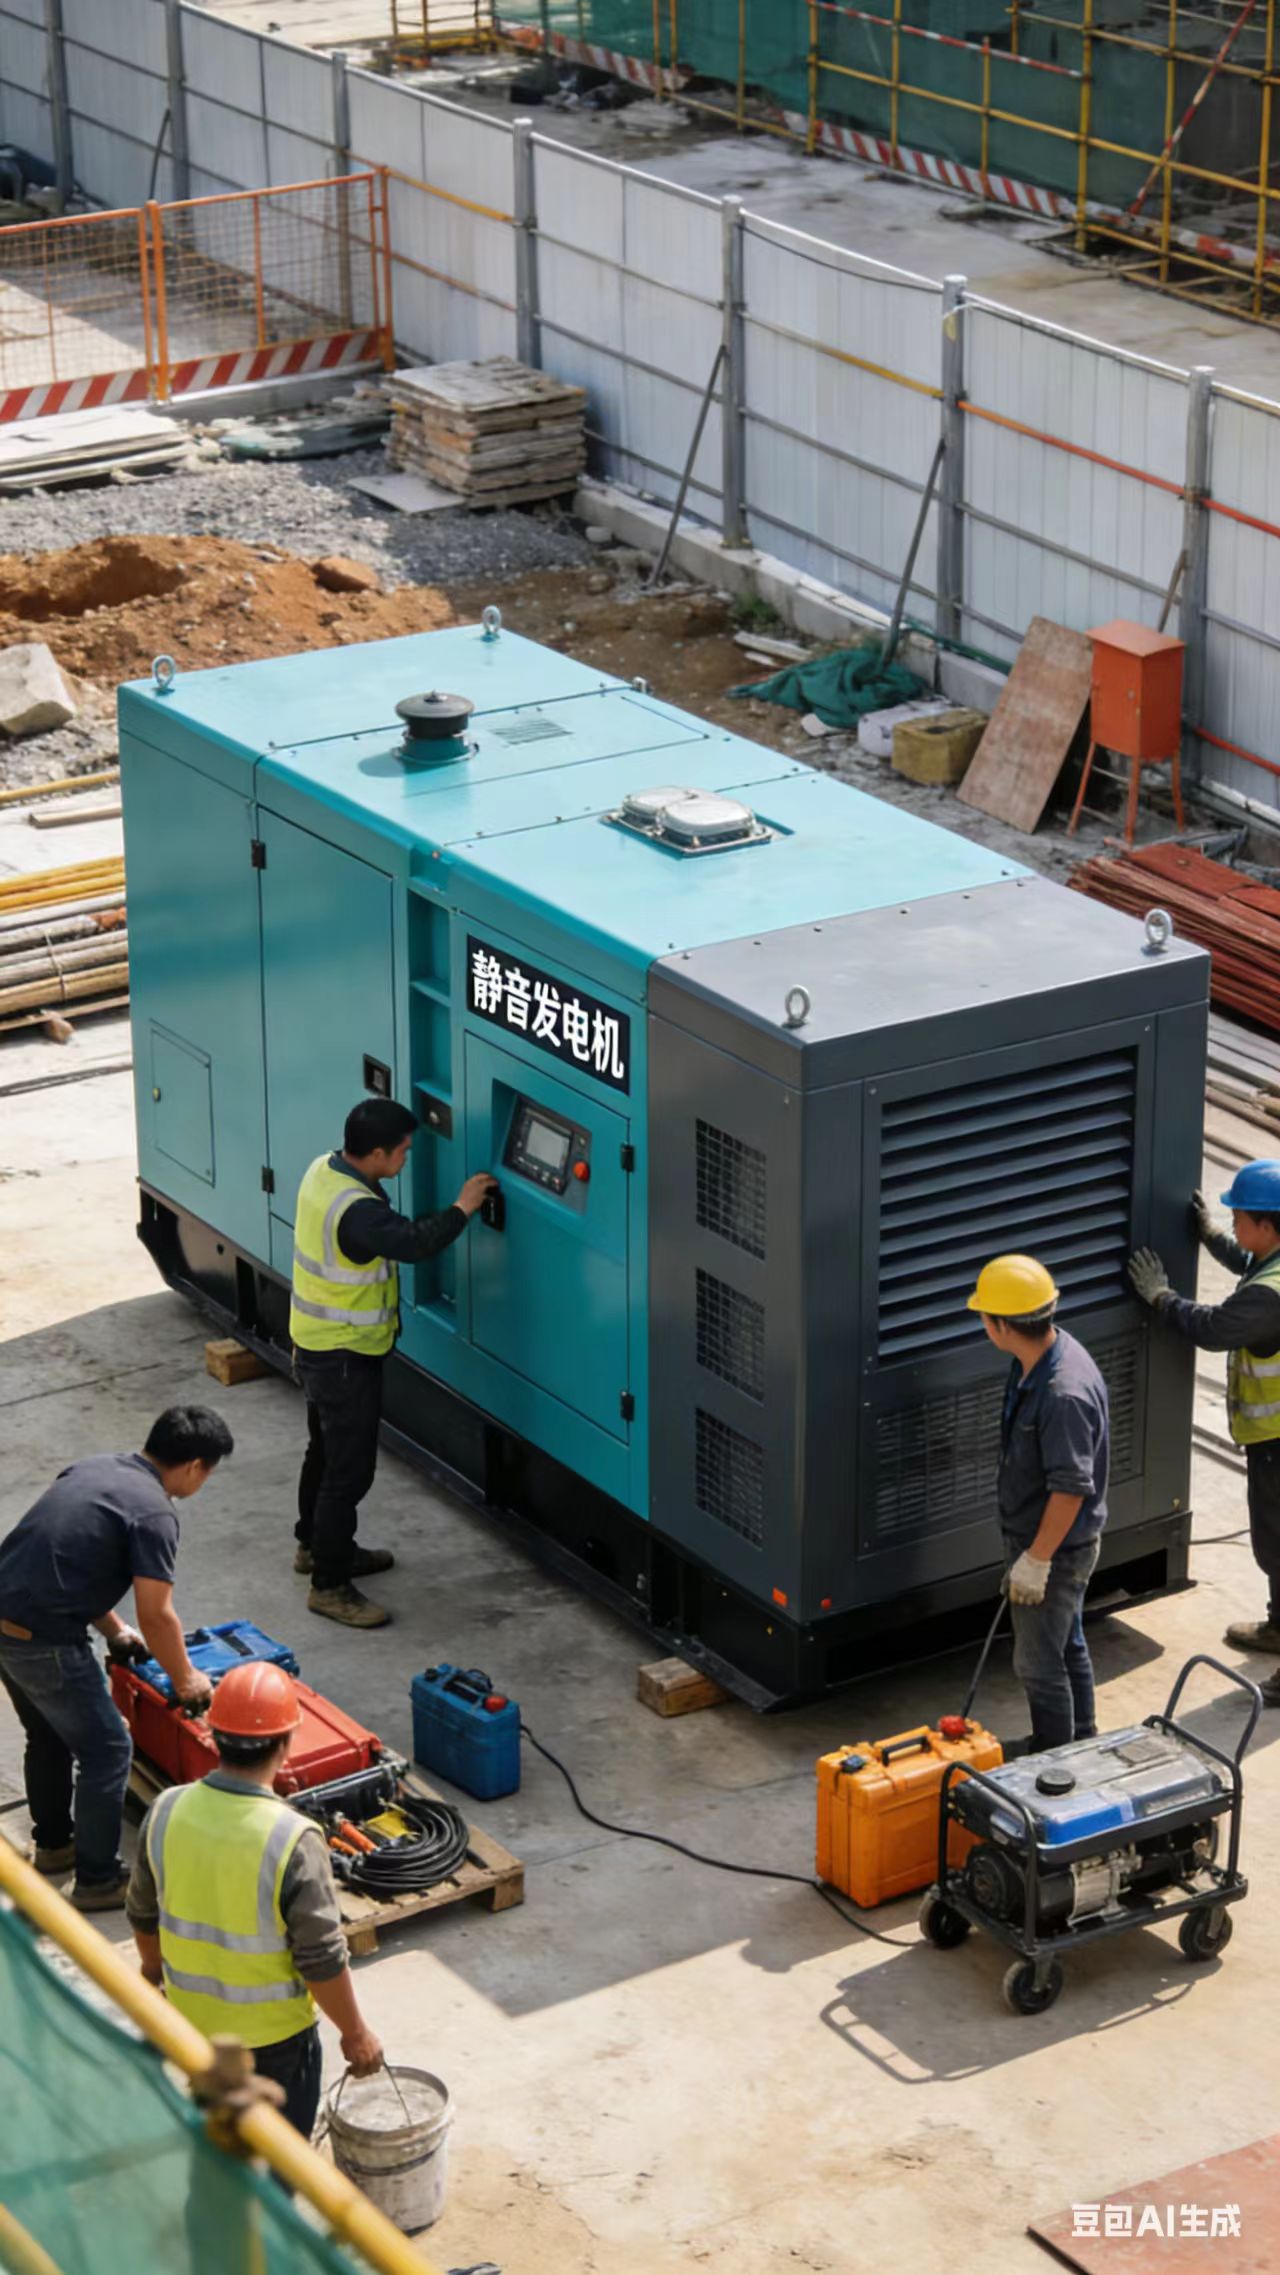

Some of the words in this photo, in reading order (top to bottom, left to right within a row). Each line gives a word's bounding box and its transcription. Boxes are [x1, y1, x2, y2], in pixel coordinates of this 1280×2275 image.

[472, 949, 624, 1079] 静音发电机
